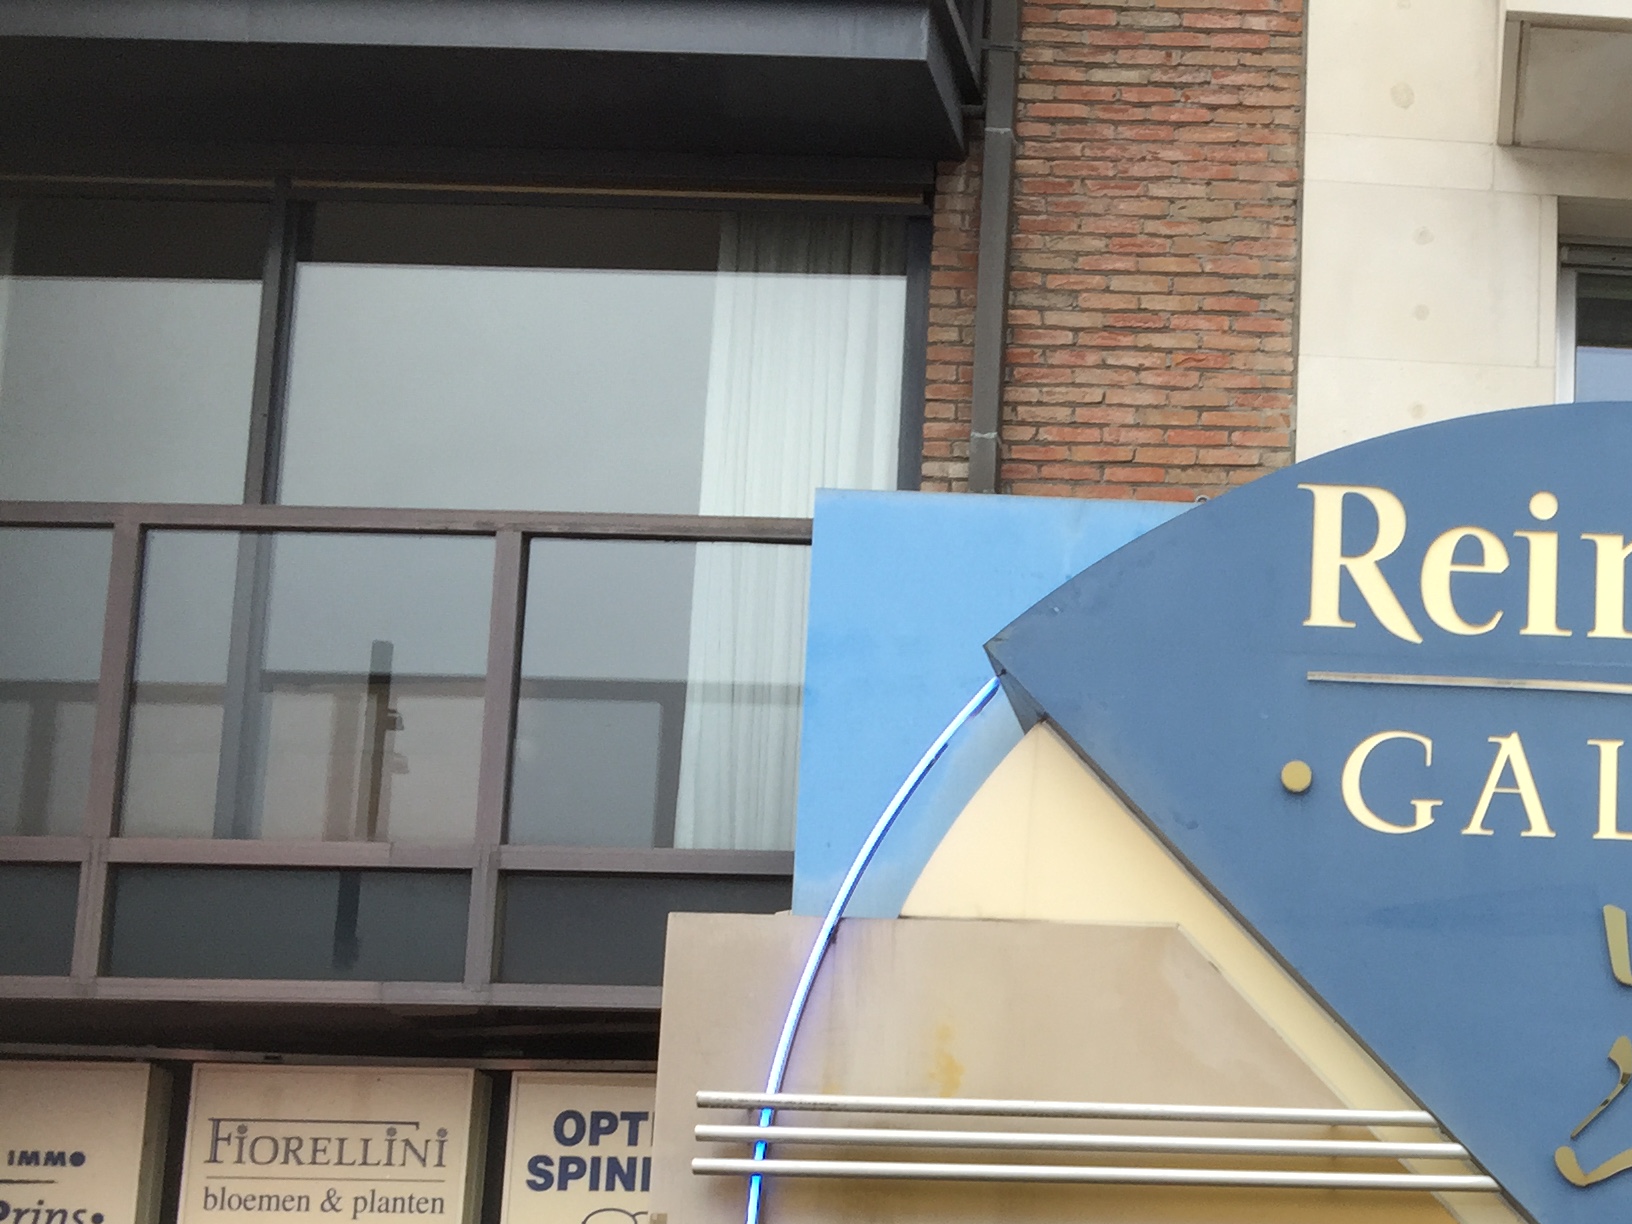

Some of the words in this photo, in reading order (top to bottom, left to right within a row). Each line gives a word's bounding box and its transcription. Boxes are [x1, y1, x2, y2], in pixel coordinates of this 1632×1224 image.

[553, 1109, 655, 1147] OPT
[7, 1150, 86, 1167] IMMO
[203, 1186, 310, 1213] bloemen
[319, 1189, 344, 1213] &
[353, 1190, 445, 1220] planten
